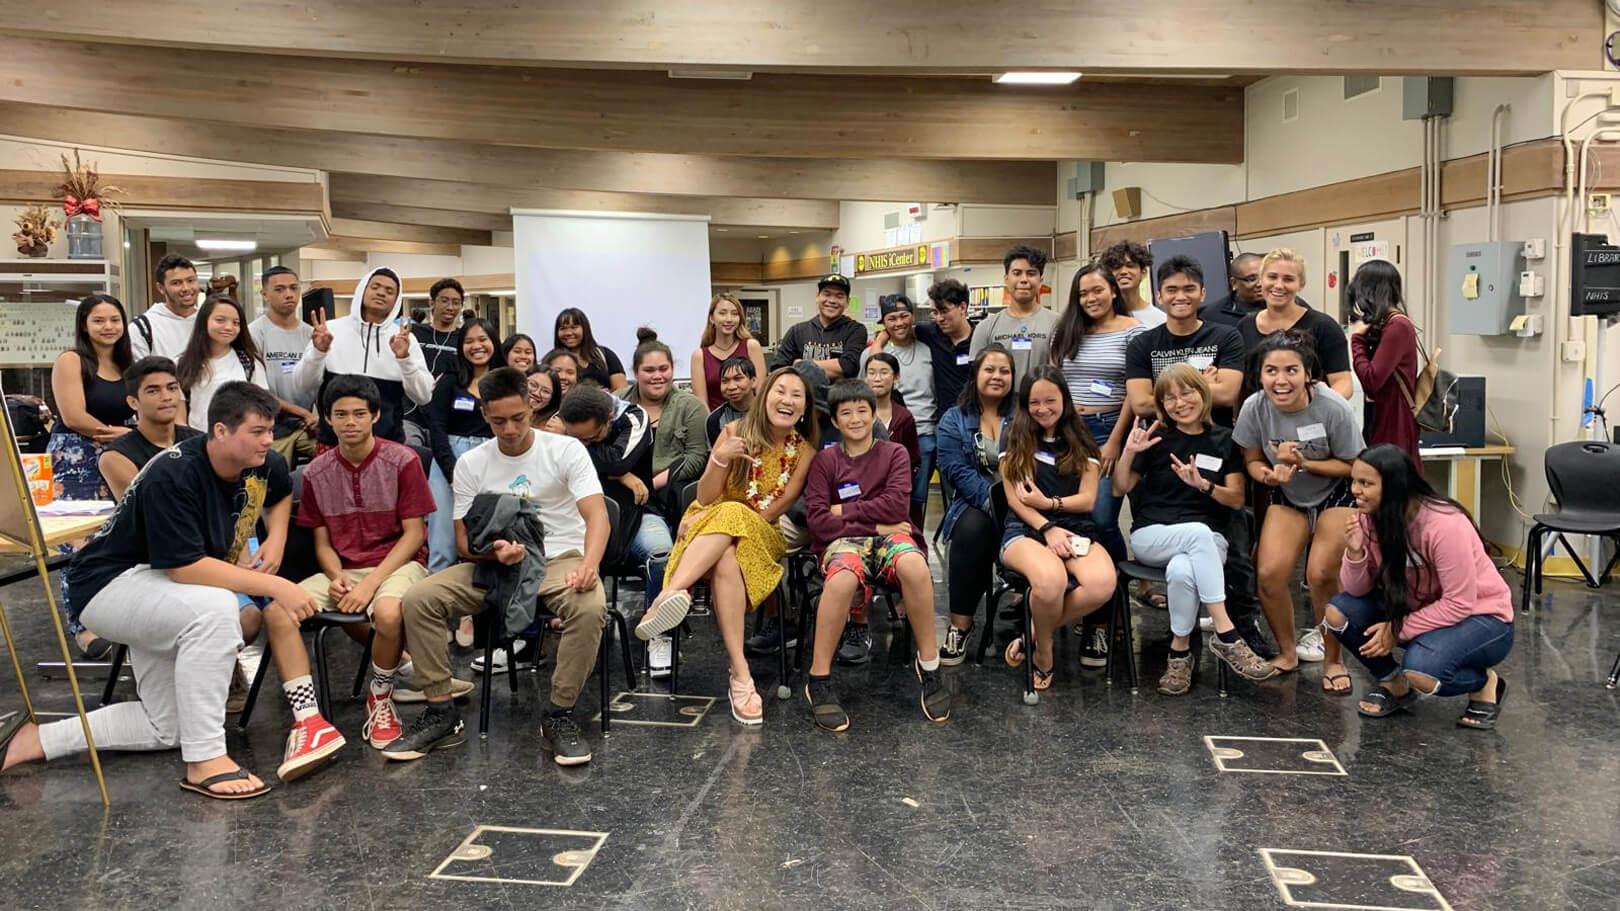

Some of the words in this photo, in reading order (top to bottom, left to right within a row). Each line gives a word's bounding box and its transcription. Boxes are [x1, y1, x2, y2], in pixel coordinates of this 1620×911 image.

[869, 254, 889, 269] NHIS
[1587, 253, 1620, 263] LIBRAR
[1585, 291, 1609, 300] NHIS
[266, 351, 298, 359] AMERICAN
[1150, 350, 1176, 358] CALVIN
[1176, 347, 1194, 356] KLEIN
[1194, 344, 1218, 354] JEANS
